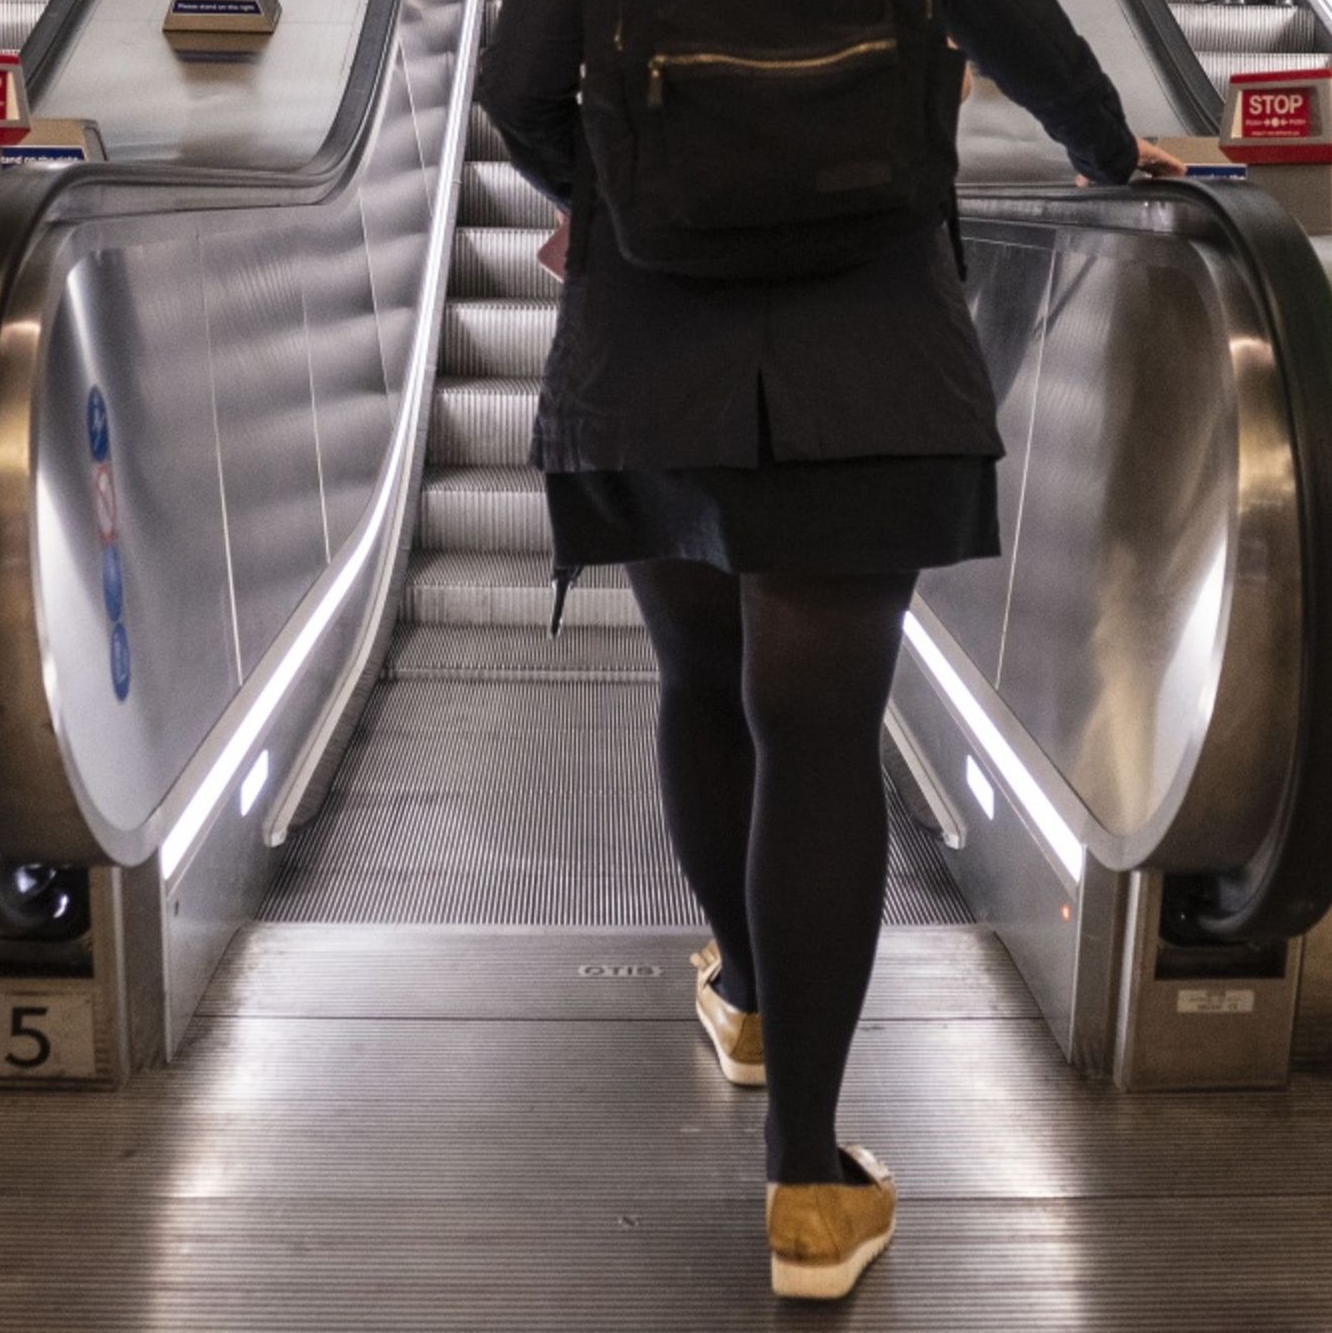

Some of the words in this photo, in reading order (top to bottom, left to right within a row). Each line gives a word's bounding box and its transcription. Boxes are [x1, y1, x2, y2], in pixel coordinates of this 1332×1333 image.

[1249, 94, 1303, 115] STOP
[584, 966, 655, 976] OTIS
[5, 1006, 51, 1068] 5
